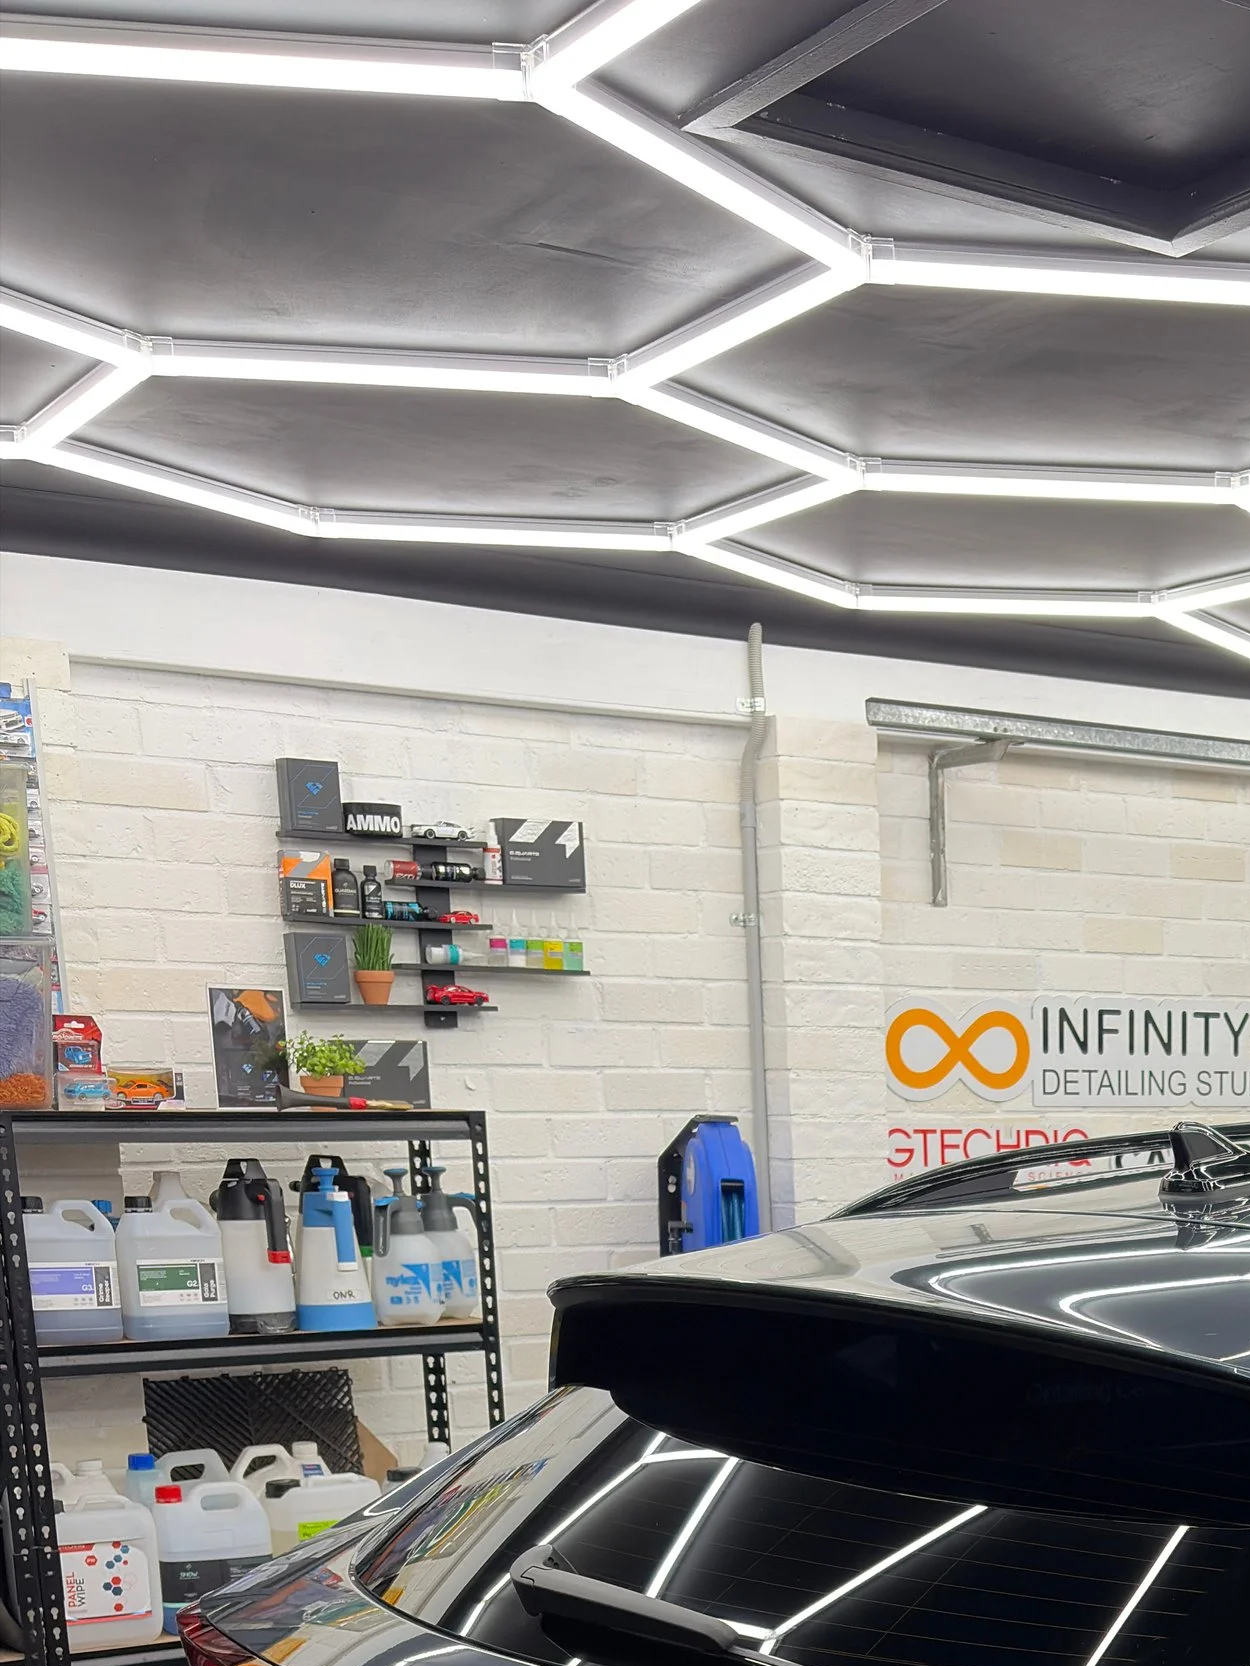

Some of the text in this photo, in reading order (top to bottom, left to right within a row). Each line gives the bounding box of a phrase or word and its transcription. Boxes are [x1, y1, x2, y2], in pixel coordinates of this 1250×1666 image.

[346, 814, 400, 834] AMMO
[1042, 1006, 1250, 1057] INFINITY
[1042, 1068, 1187, 1096] DETAILING
[332, 1289, 356, 1300] ONR
[66, 1571, 77, 1608] PANEL
[76, 1577, 86, 1608] WIPE
